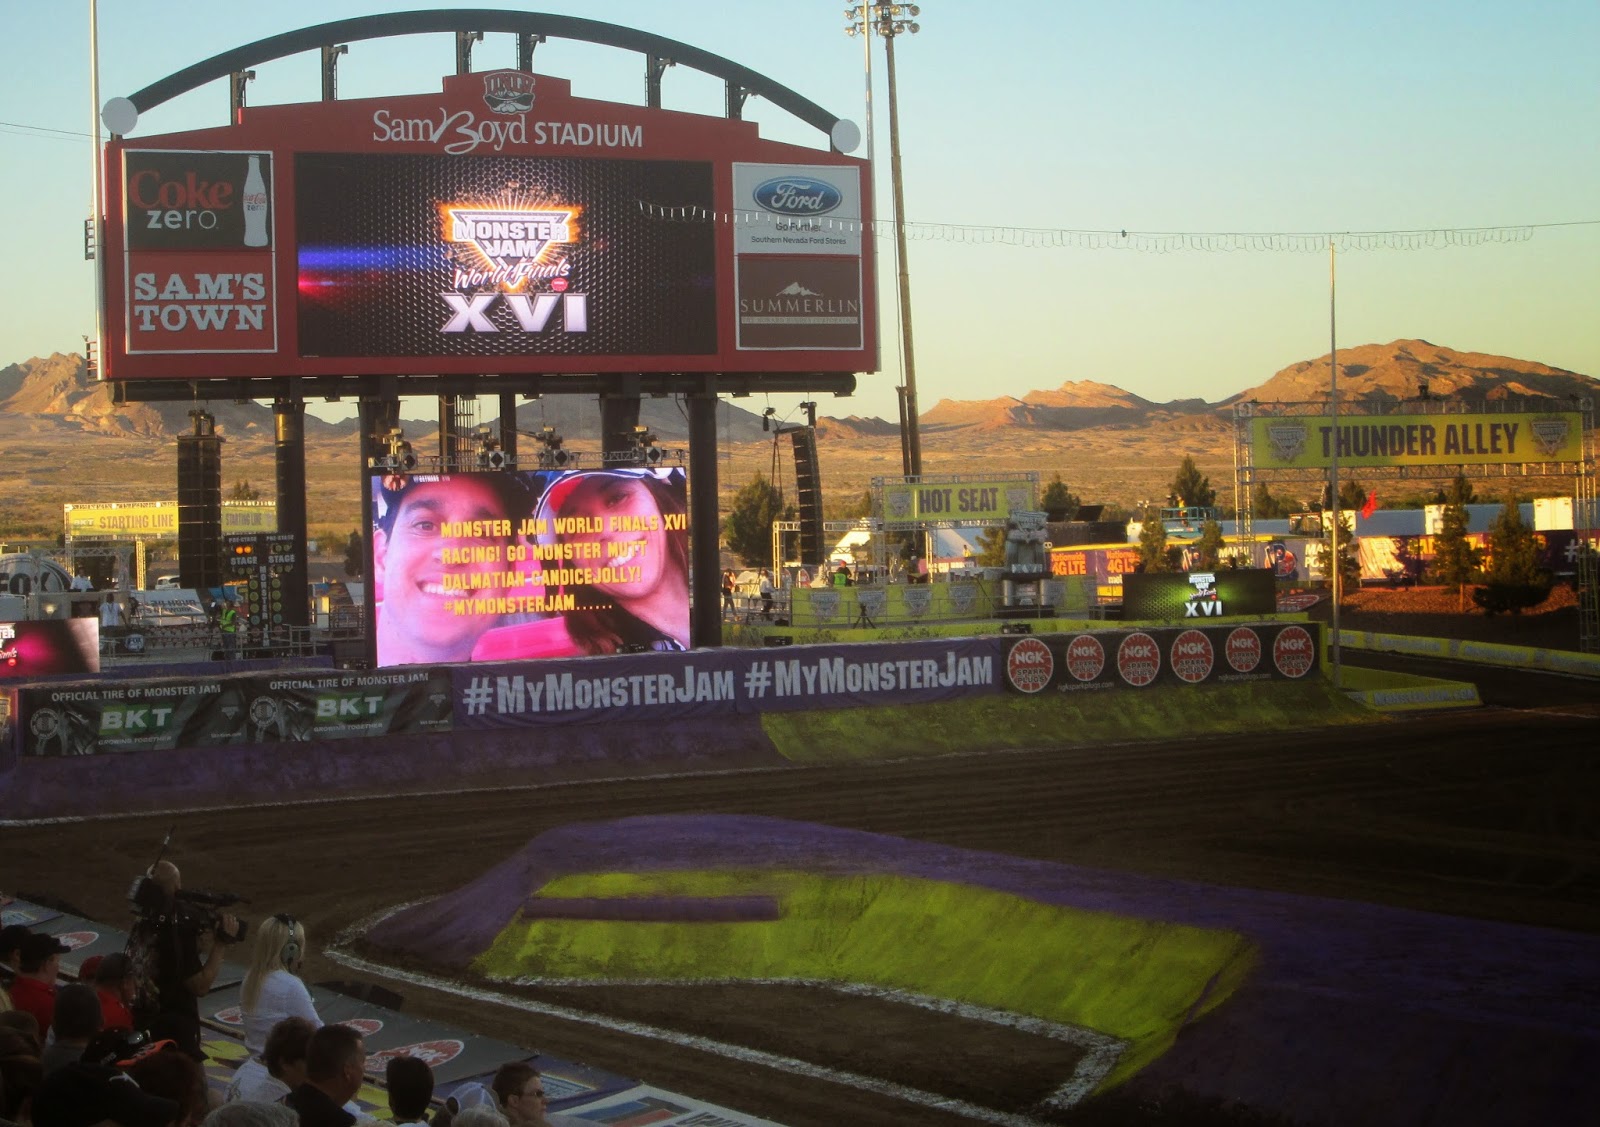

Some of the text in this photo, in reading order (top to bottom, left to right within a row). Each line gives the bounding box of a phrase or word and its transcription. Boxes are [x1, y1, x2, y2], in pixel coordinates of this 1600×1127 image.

[373, 108, 642, 155] Sam Boyd STADIUM
[129, 171, 233, 209] Coke
[771, 182, 825, 210] Ford
[146, 210, 217, 229] zero
[454, 221, 567, 240] MONSTER
[485, 239, 537, 257] JAM
[454, 258, 571, 289] World Finals
[134, 273, 266, 301] SAM'S
[439, 293, 587, 333] XVI
[741, 299, 858, 313] SUMMERLIN
[134, 304, 266, 331] TOWN
[1319, 423, 1436, 457] THUNDER
[1444, 422, 1519, 455] ALLEY
[919, 488, 952, 513] HOT
[958, 487, 999, 512] SEAT
[100, 515, 148, 529] STARTING
[152, 514, 173, 528] LINE
[440, 513, 686, 538] MONSTER JAM WORLD FINALS XVI
[230, 554, 295, 565] STAGE STAGE
[442, 540, 648, 564] RACING! GO MONSTER MUTT
[1052, 560, 1086, 576] 4G LTE
[1107, 558, 1123, 573] 4G
[443, 566, 642, 590] DALMATIAN CANDICEJOLLY!
[260, 566, 268, 620] MONSTER
[1184, 600, 1222, 617] XVI
[1073, 646, 1097, 657] NGK
[1125, 645, 1152, 658] NGK
[1178, 642, 1205, 655] NGK
[1231, 638, 1254, 649] NGK
[1280, 638, 1306, 650] NGK
[1015, 651, 1044, 664] NGK
[269, 672, 428, 690] OFFICIAL TIRE OF MONSTER JAM
[1017, 676, 1045, 684] PLUGS
[1057, 681, 1114, 691] ngksparkplugs.com
[51, 684, 221, 701] OFFICIAL TIRE OF MONSTER JAM
[317, 695, 383, 717] BKT
[101, 708, 172, 730] BKT
[314, 723, 383, 733] GROWING TOGETHER
